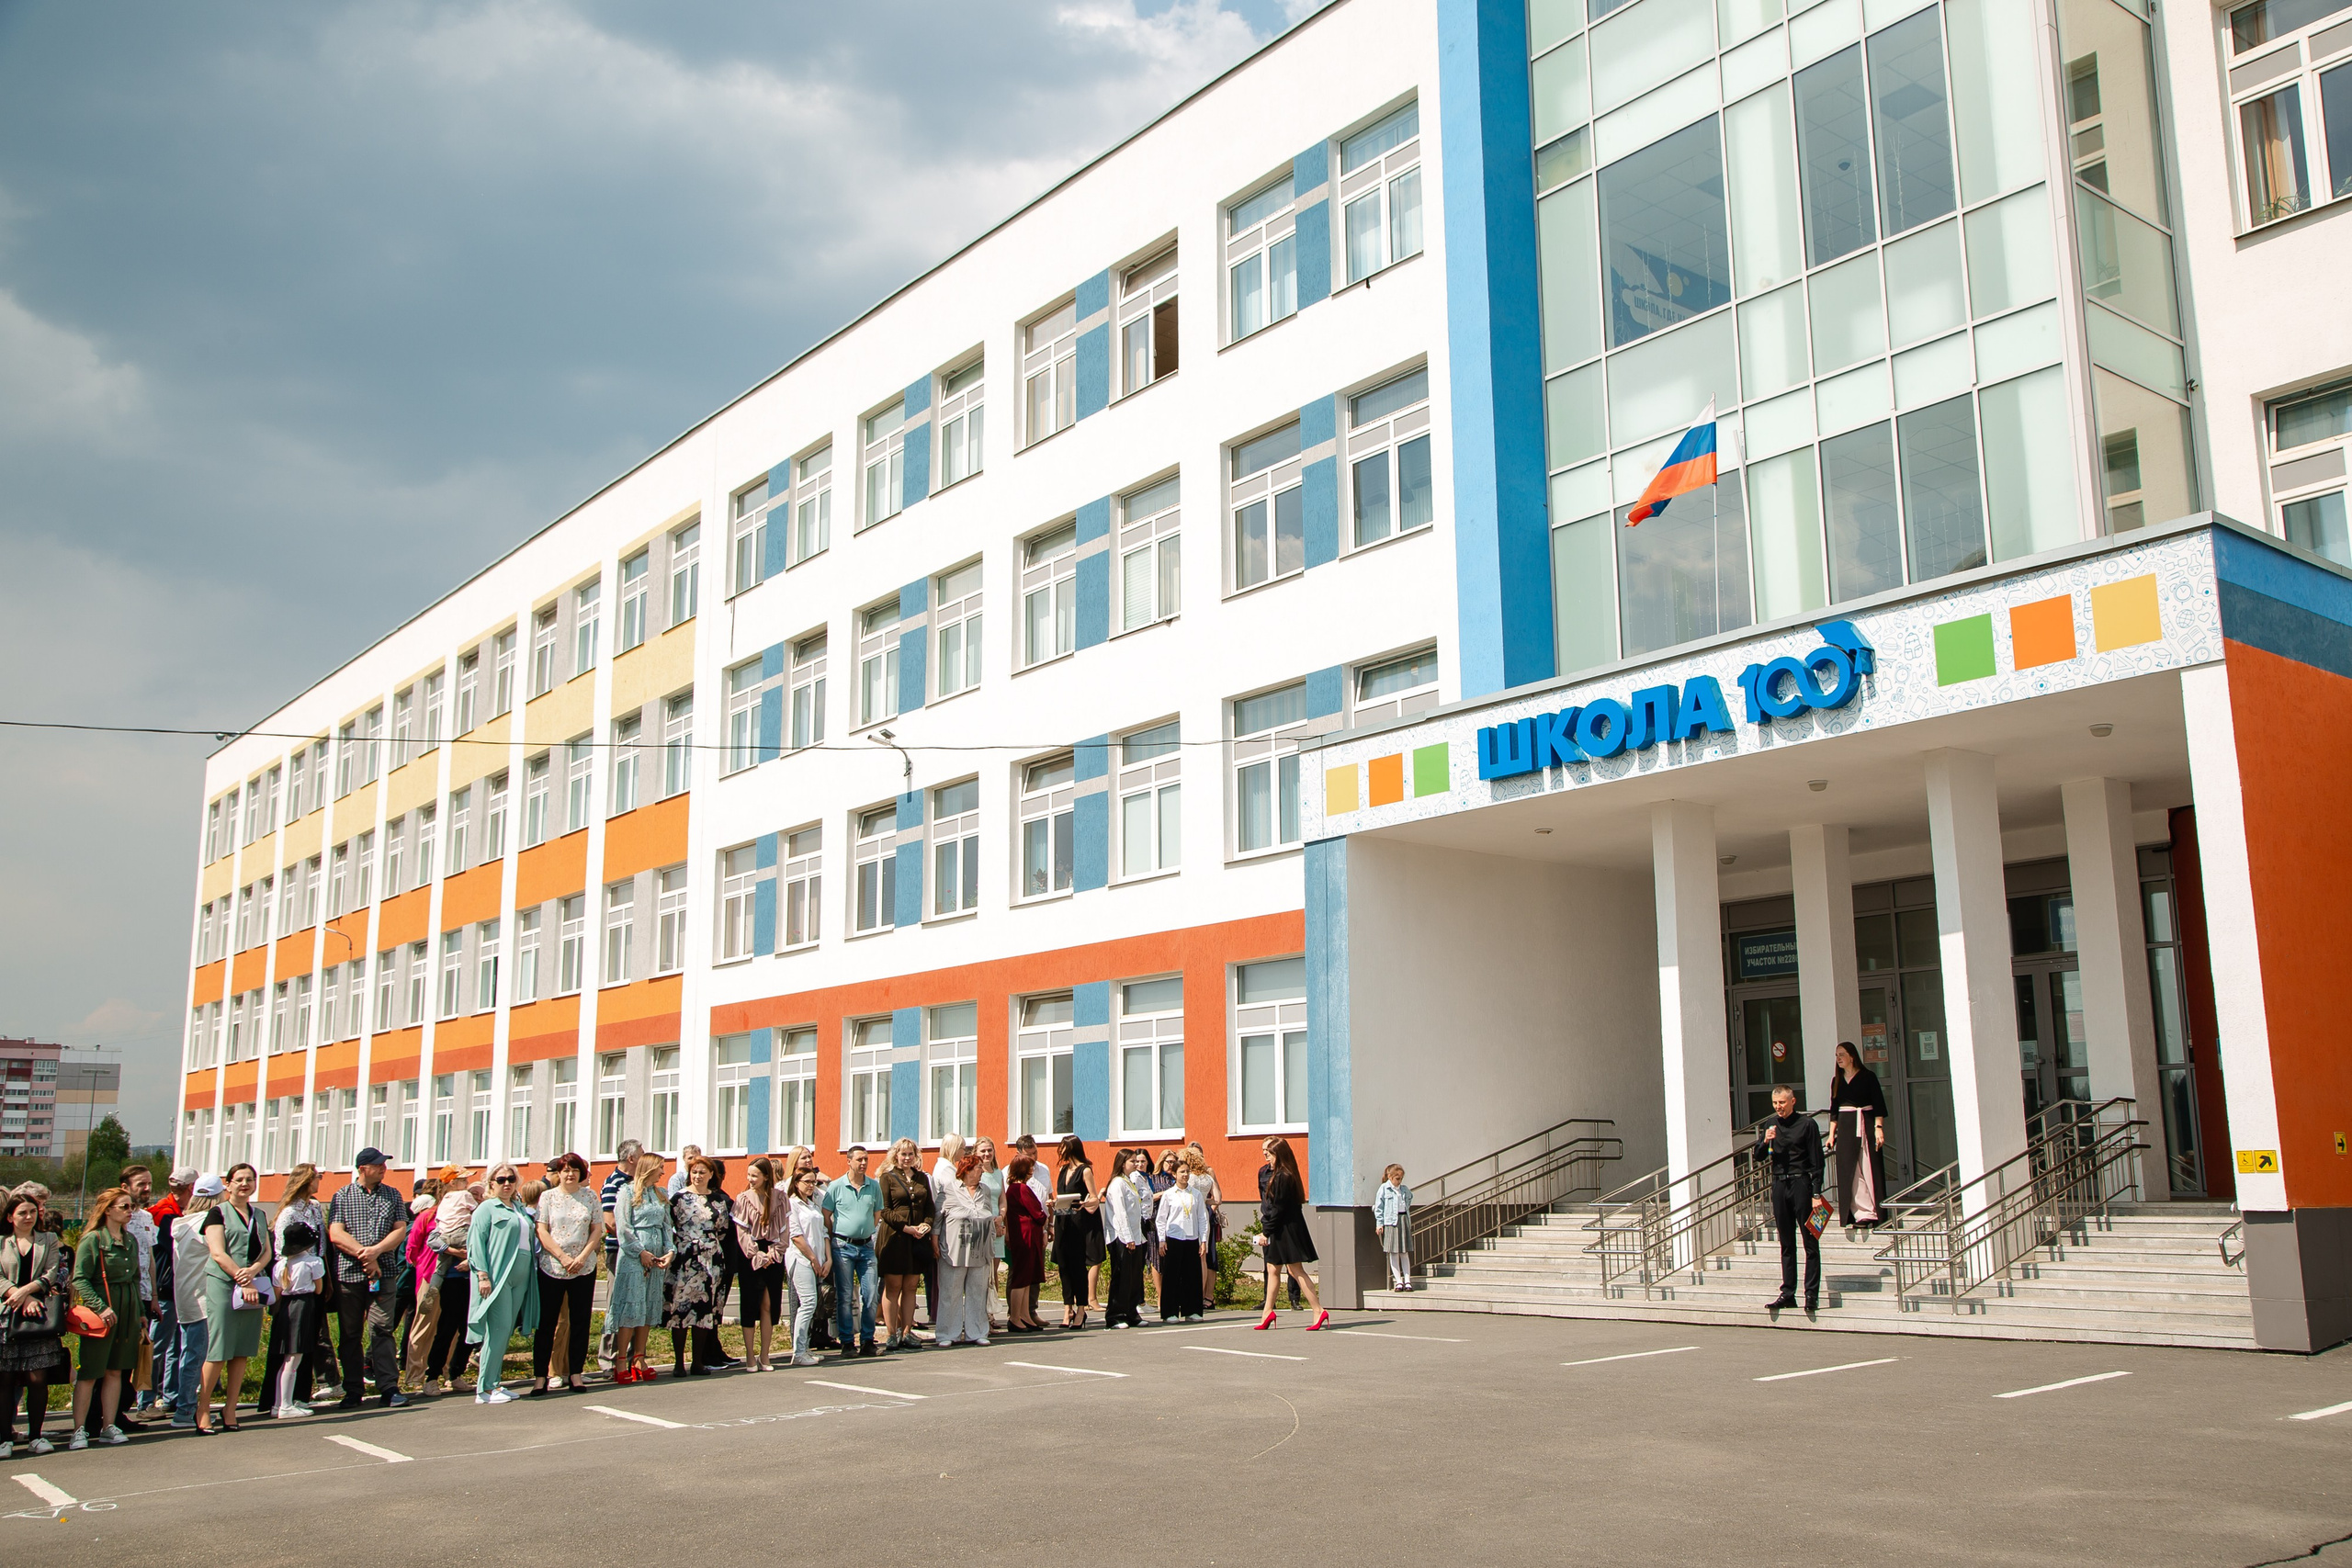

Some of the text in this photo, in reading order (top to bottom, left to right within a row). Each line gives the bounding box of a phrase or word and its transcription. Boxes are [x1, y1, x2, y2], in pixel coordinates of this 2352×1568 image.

[1477, 645, 1862, 781] ШКОЛА 100
[1744, 942, 1797, 955] ИЗБИРАТЕЛЬНЫ
[1747, 956, 1777, 967] УЧАСТОК
